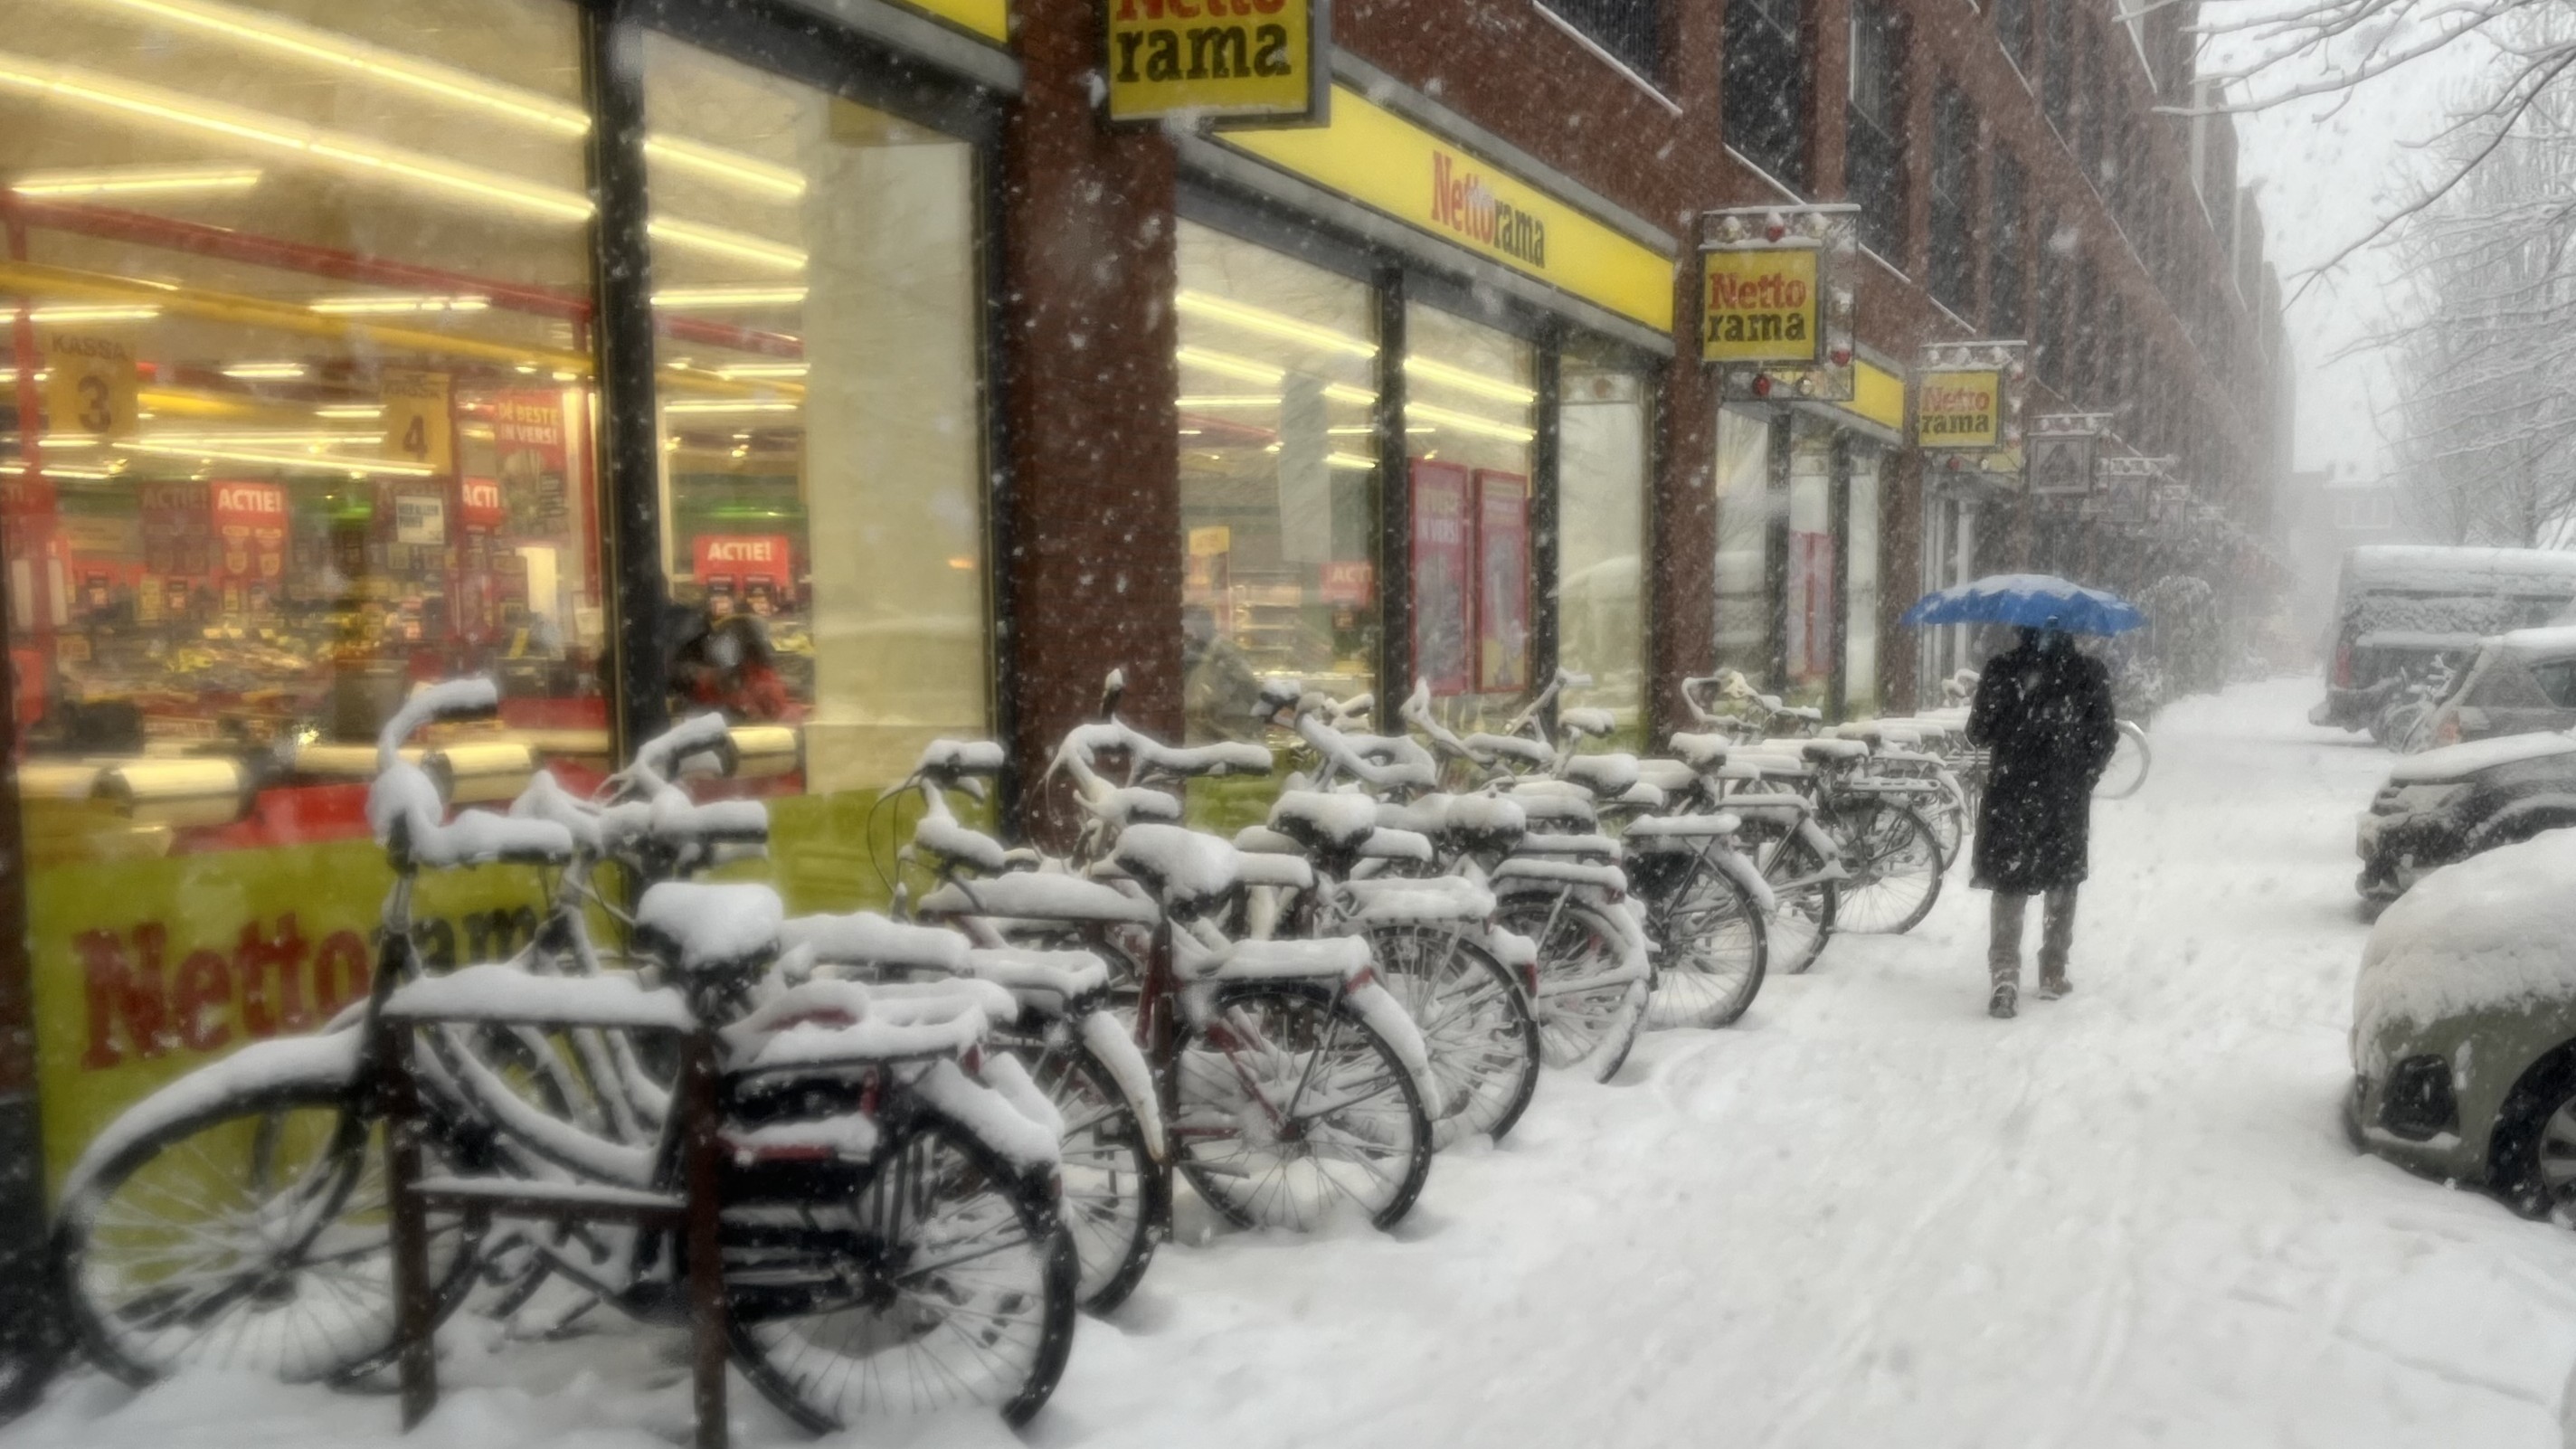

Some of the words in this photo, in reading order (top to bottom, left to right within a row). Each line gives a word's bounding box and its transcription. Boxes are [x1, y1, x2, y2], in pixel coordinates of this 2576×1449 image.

[1115, 23, 1293, 83] rama
[1707, 271, 1807, 310] Netto
[1707, 312, 1807, 343] rama
[78, 375, 111, 432] 3
[402, 414, 428, 459] 4
[1920, 413, 1991, 435] rama
[217, 488, 282, 513] ACTIE!
[706, 542, 772, 562] ACTIE!
